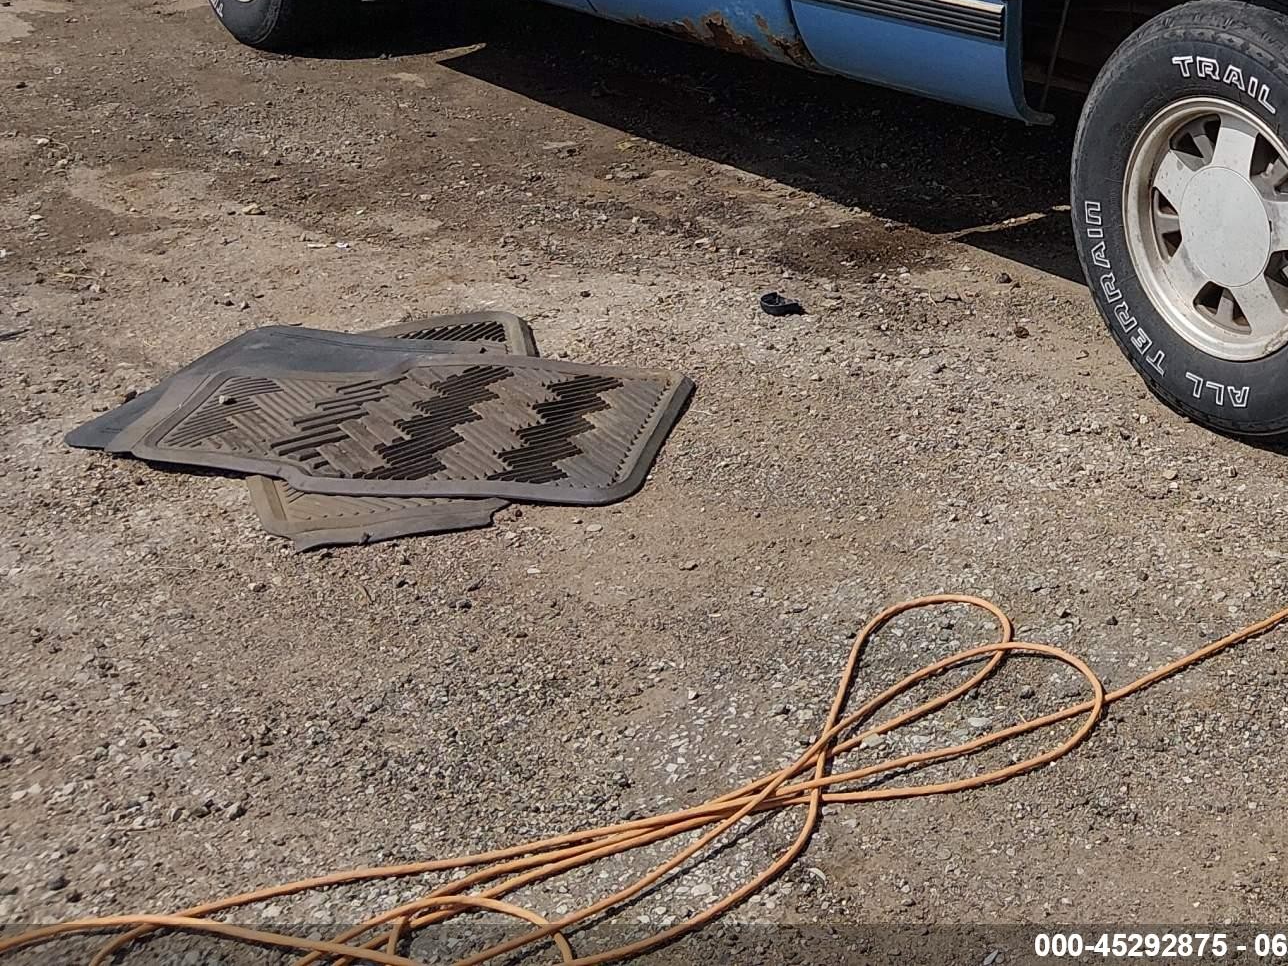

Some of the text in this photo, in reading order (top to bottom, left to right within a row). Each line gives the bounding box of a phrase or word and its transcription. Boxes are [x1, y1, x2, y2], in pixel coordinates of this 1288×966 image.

[1172, 55, 1276, 115] TRAIL
[1084, 200, 1250, 408] ALL TERRAIN
